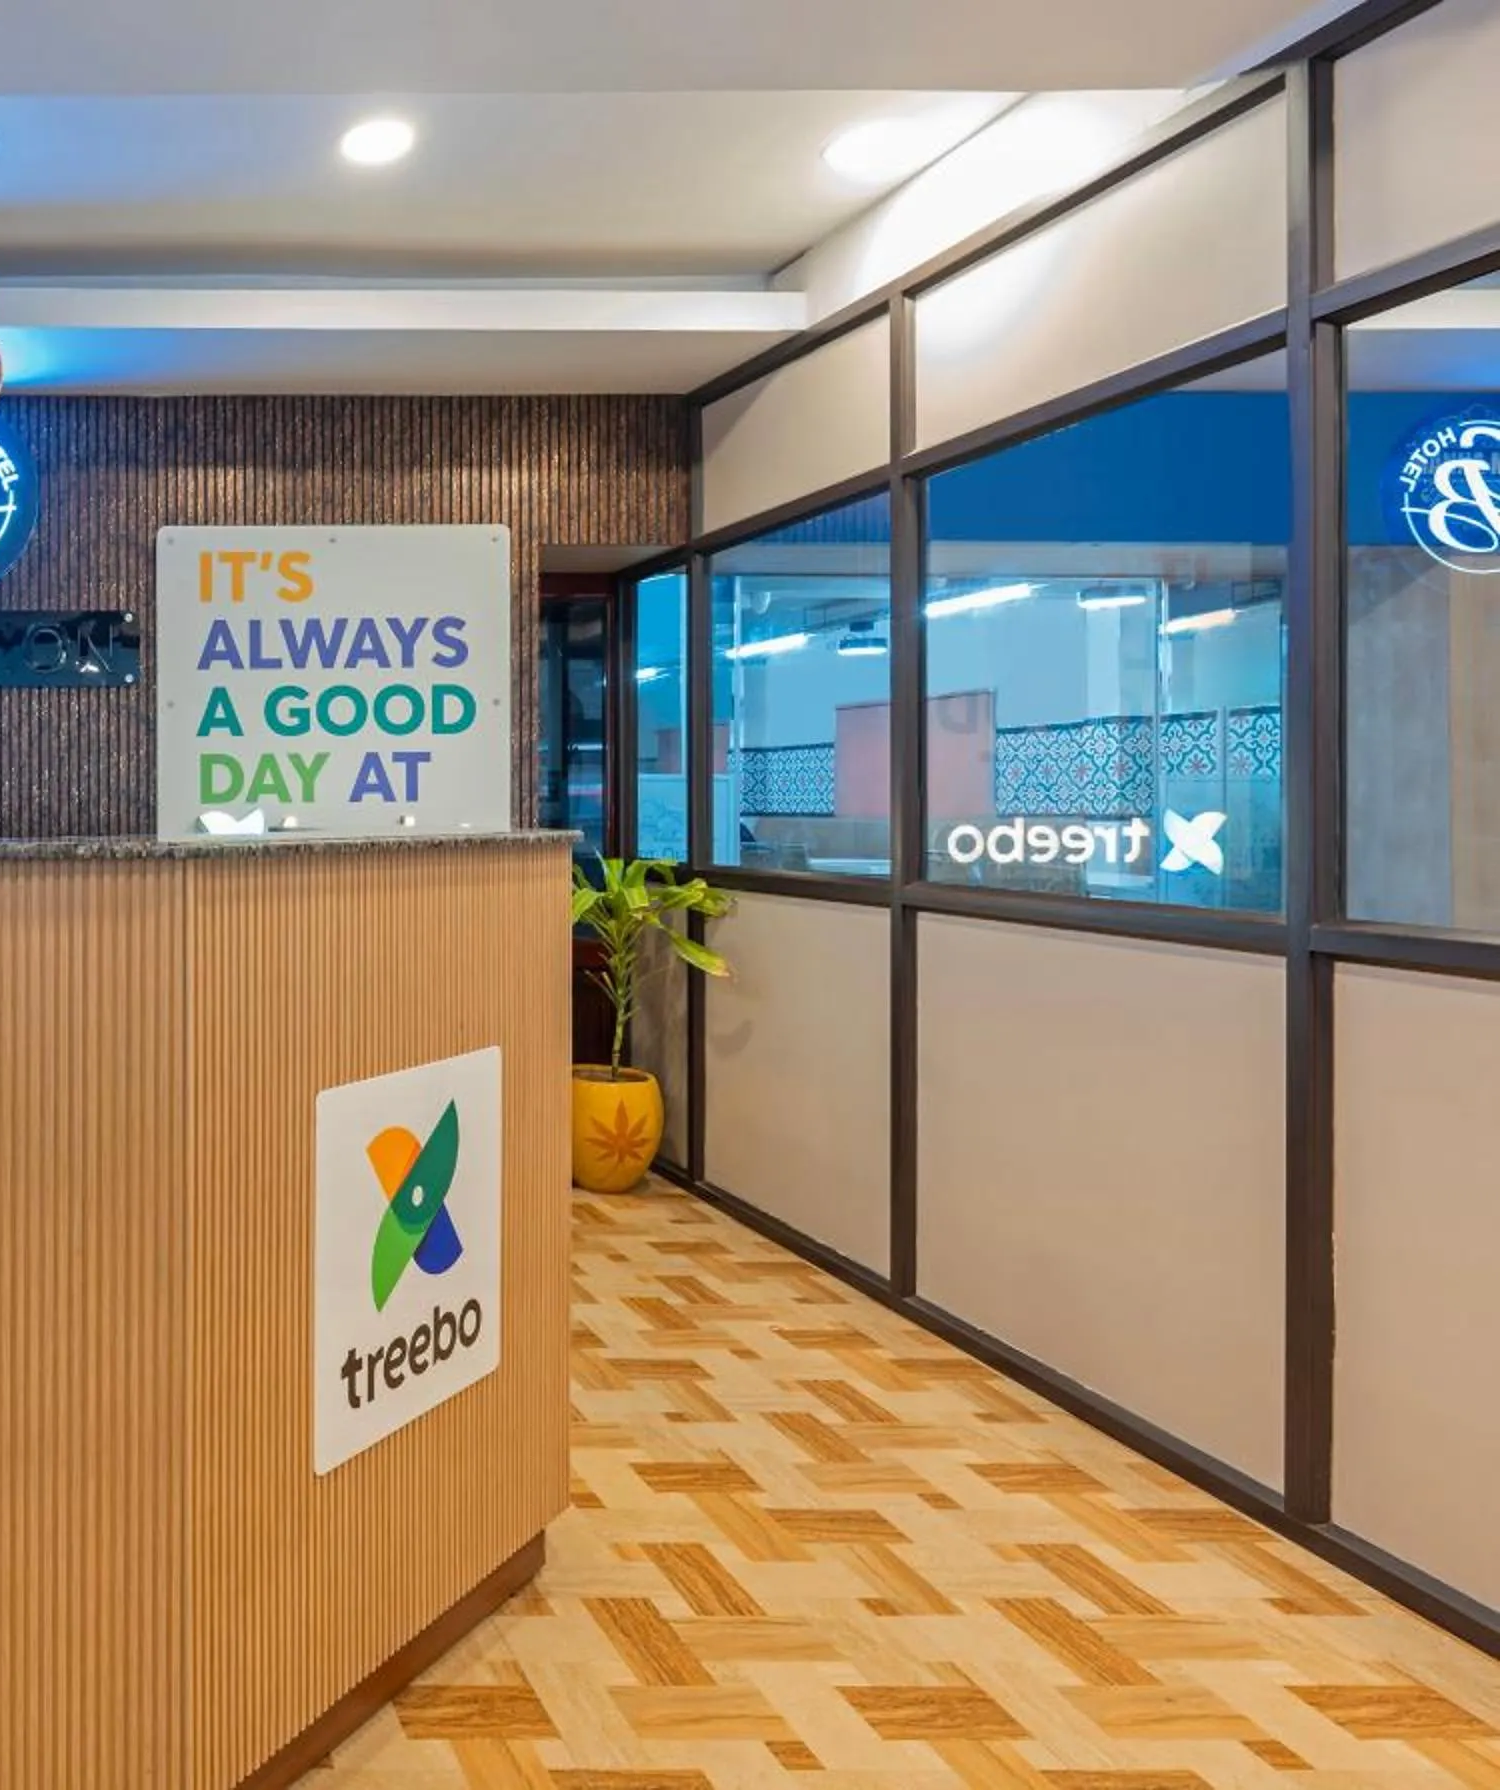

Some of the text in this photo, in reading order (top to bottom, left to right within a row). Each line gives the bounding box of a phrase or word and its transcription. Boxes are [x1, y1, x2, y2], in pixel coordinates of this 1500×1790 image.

[198, 550, 314, 604] IT'S
[197, 616, 470, 670] ALWAYS
[196, 684, 478, 737] A GOOD
[199, 752, 432, 806] DAY AT
[340, 1298, 482, 1409] treebo
